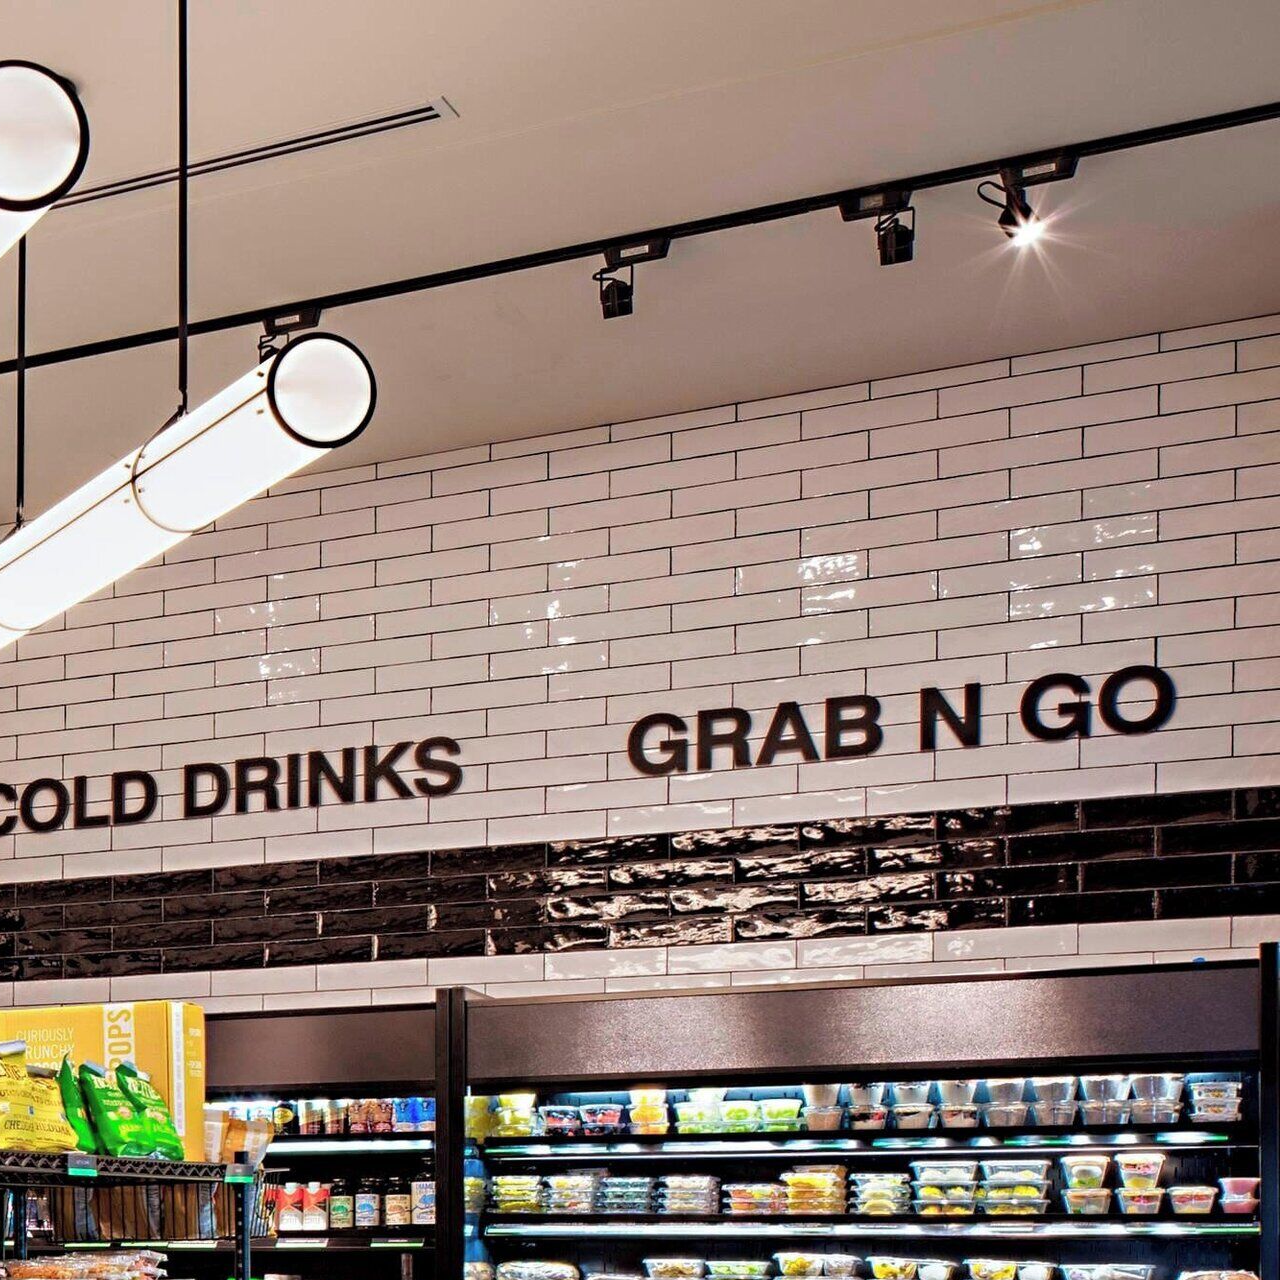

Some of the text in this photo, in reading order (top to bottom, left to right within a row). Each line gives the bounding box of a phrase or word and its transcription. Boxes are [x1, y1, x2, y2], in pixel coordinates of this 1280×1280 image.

[628, 665, 1177, 775] GRAB N GO
[182, 736, 463, 816] DRINKS
